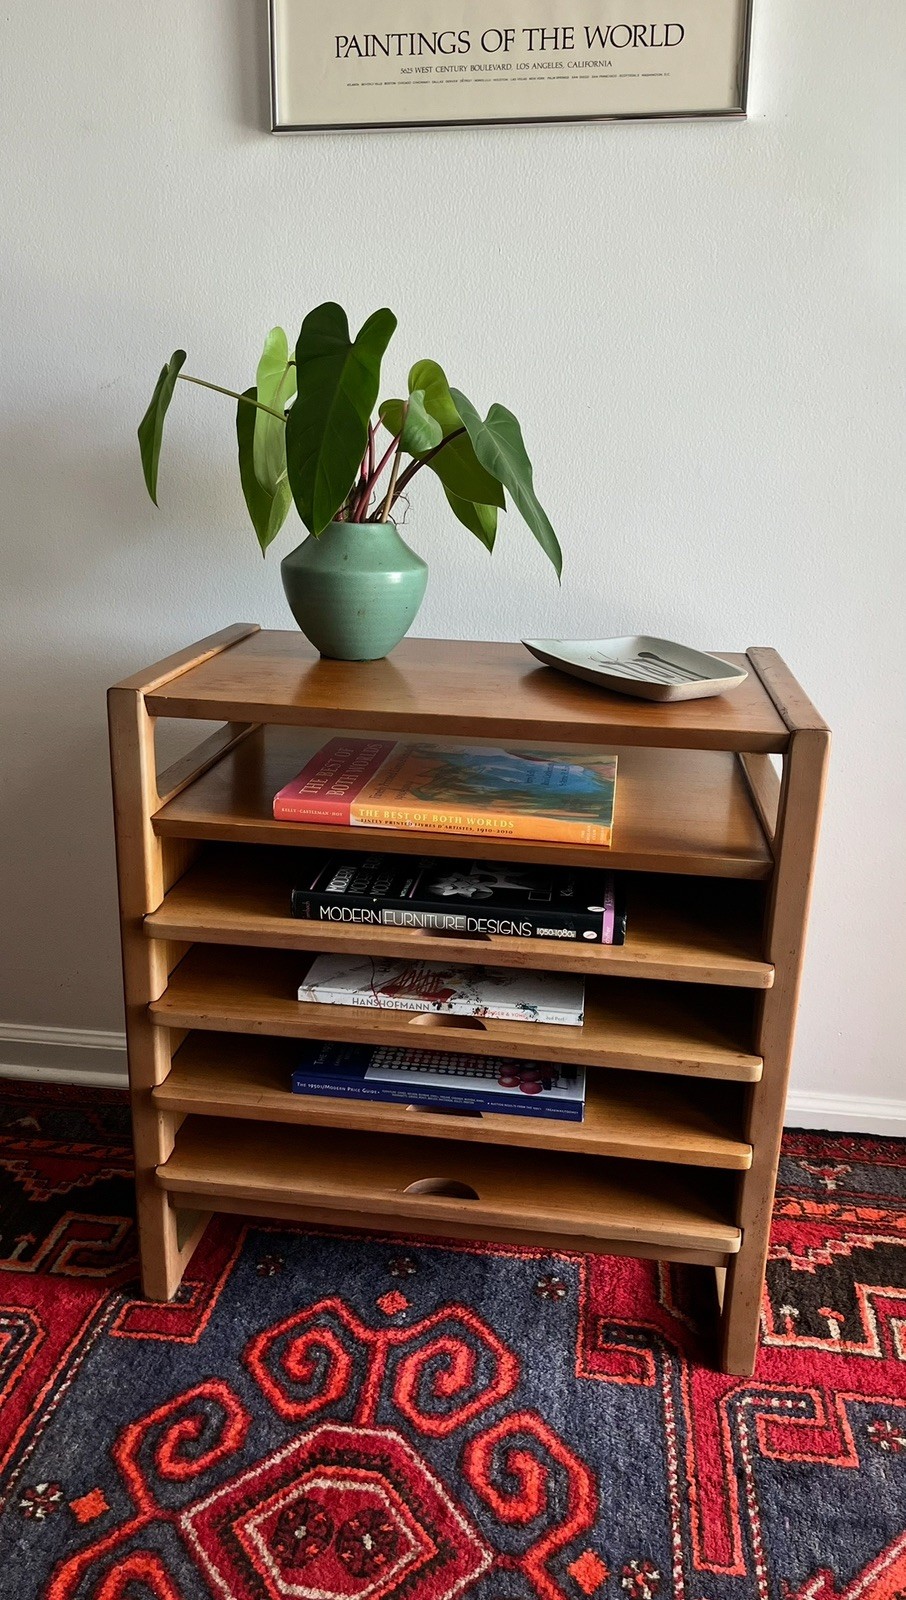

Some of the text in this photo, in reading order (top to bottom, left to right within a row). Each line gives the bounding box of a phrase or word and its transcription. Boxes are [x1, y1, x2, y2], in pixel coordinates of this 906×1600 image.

[335, 23, 685, 58] PAINTINGS OF THE WORLD
[414, 66, 433, 74] WEST
[435, 65, 468, 73] CENTURY
[567, 60, 613, 68] CALIFORNIA
[298, 778, 329, 795] THE
[315, 758, 346, 777] BEST
[325, 743, 384, 796] BOTH WORLDS
[359, 808, 515, 828] THE BEST OF BOTH WORLDS
[319, 905, 383, 924] MODERN
[384, 911, 465, 931] FURNITURE
[467, 917, 533, 937] DESIGNS
